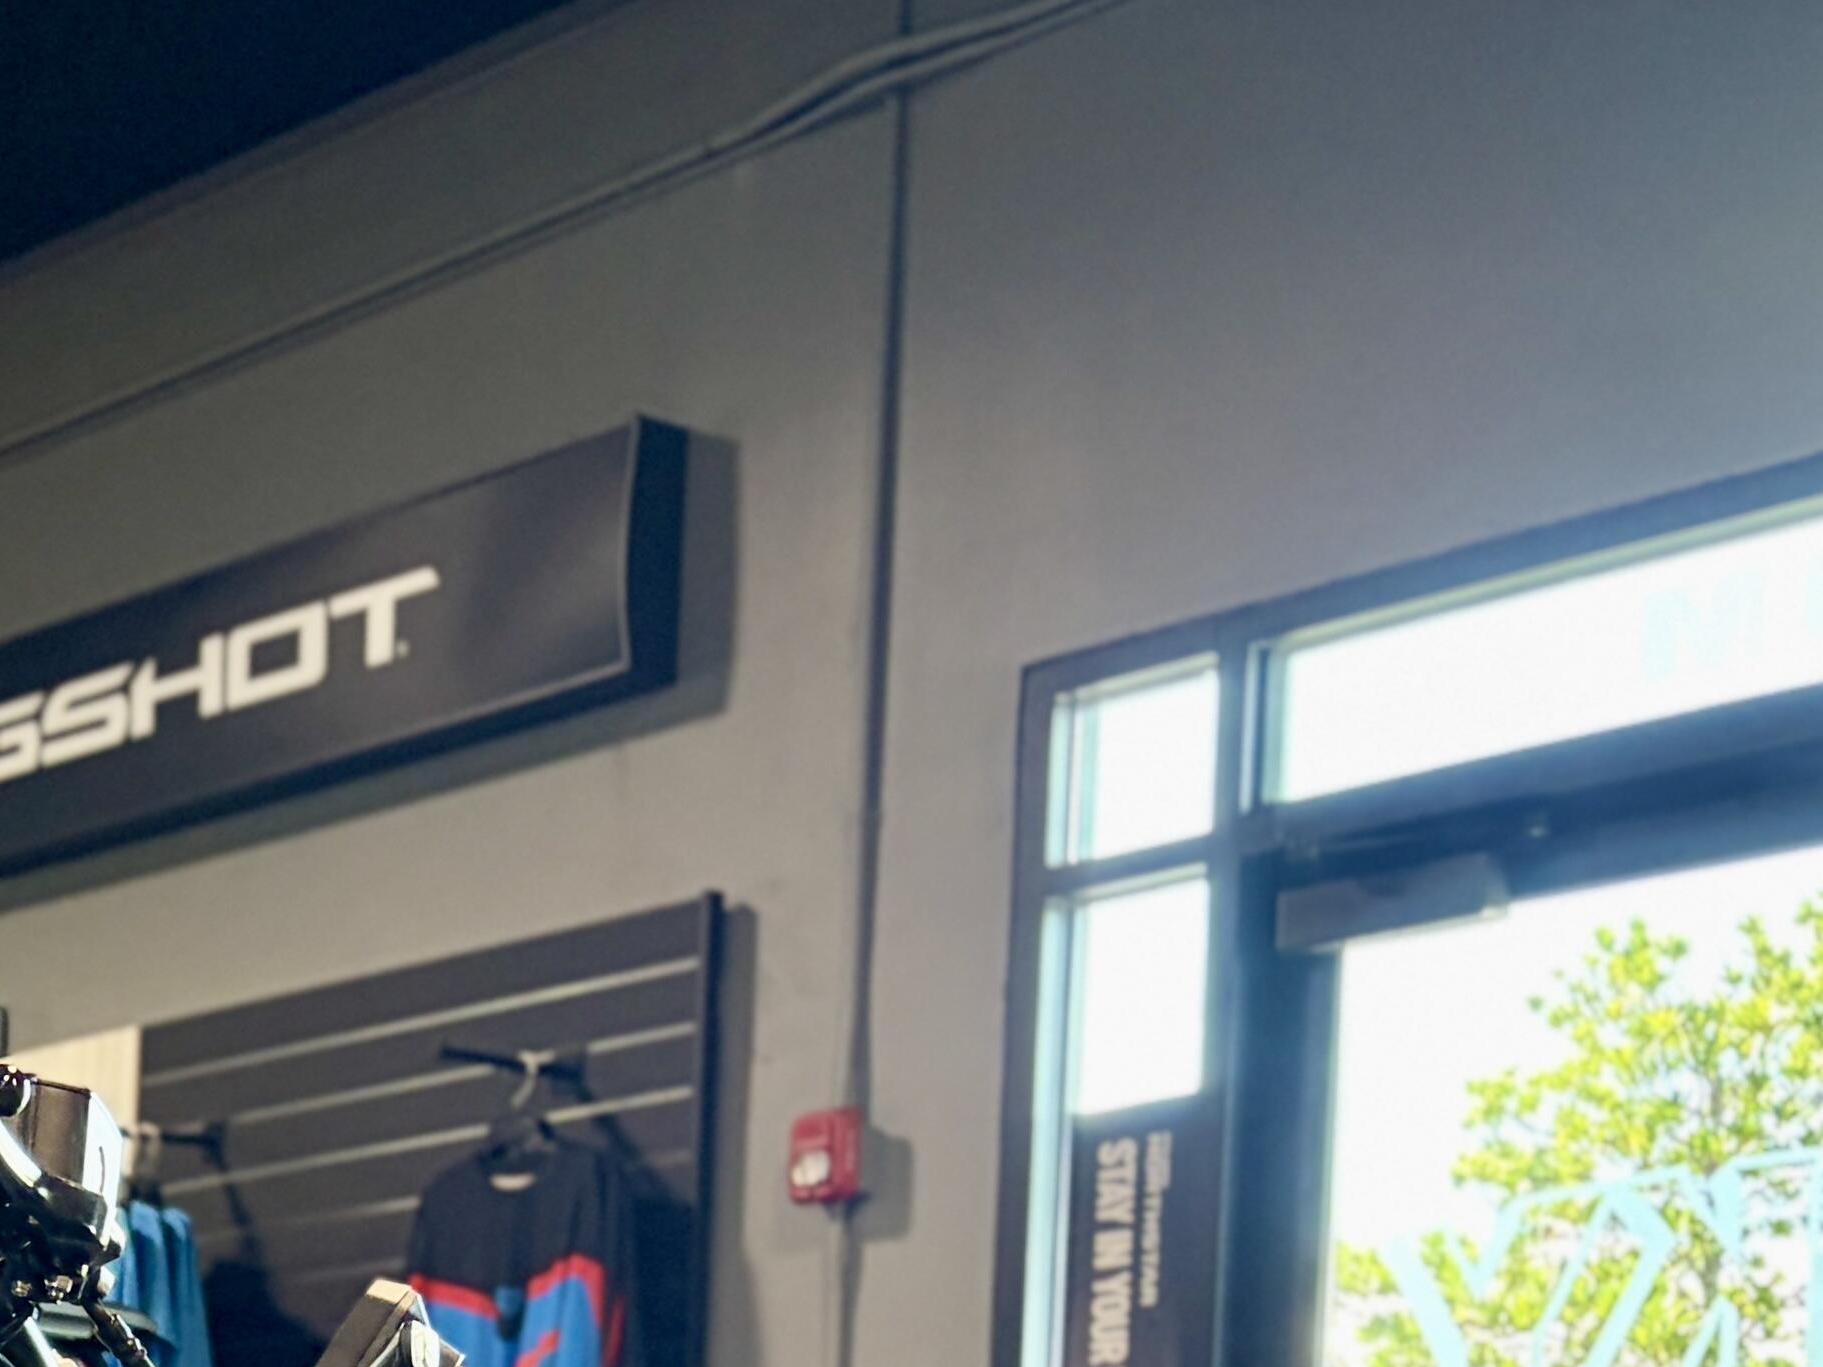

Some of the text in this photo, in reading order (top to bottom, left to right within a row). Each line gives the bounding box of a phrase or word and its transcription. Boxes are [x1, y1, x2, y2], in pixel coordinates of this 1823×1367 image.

[1093, 1136, 1138, 1218] STAY
[1091, 1229, 1132, 1268] IN
[1087, 1272, 1131, 1366] YOUR
